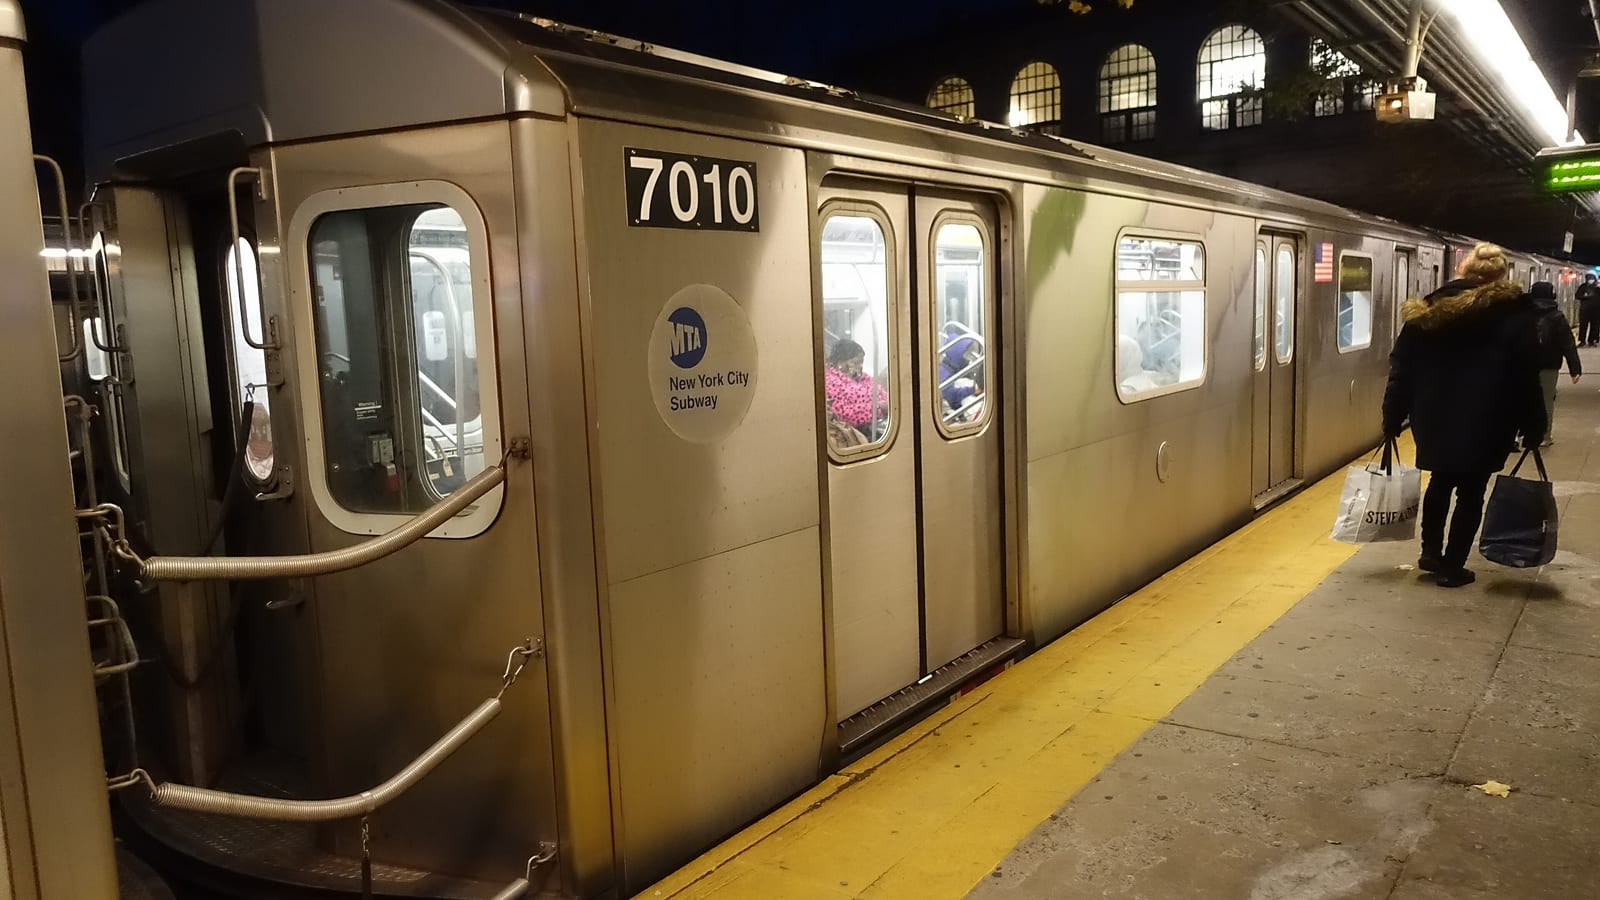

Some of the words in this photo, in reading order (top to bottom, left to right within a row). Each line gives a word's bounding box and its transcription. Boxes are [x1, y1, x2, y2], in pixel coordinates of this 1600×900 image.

[630, 156, 755, 224] 7010
[667, 320, 702, 356] MTA
[669, 377, 696, 391] New
[698, 373, 724, 388] York
[727, 371, 749, 387] City
[670, 395, 718, 411] Subway
